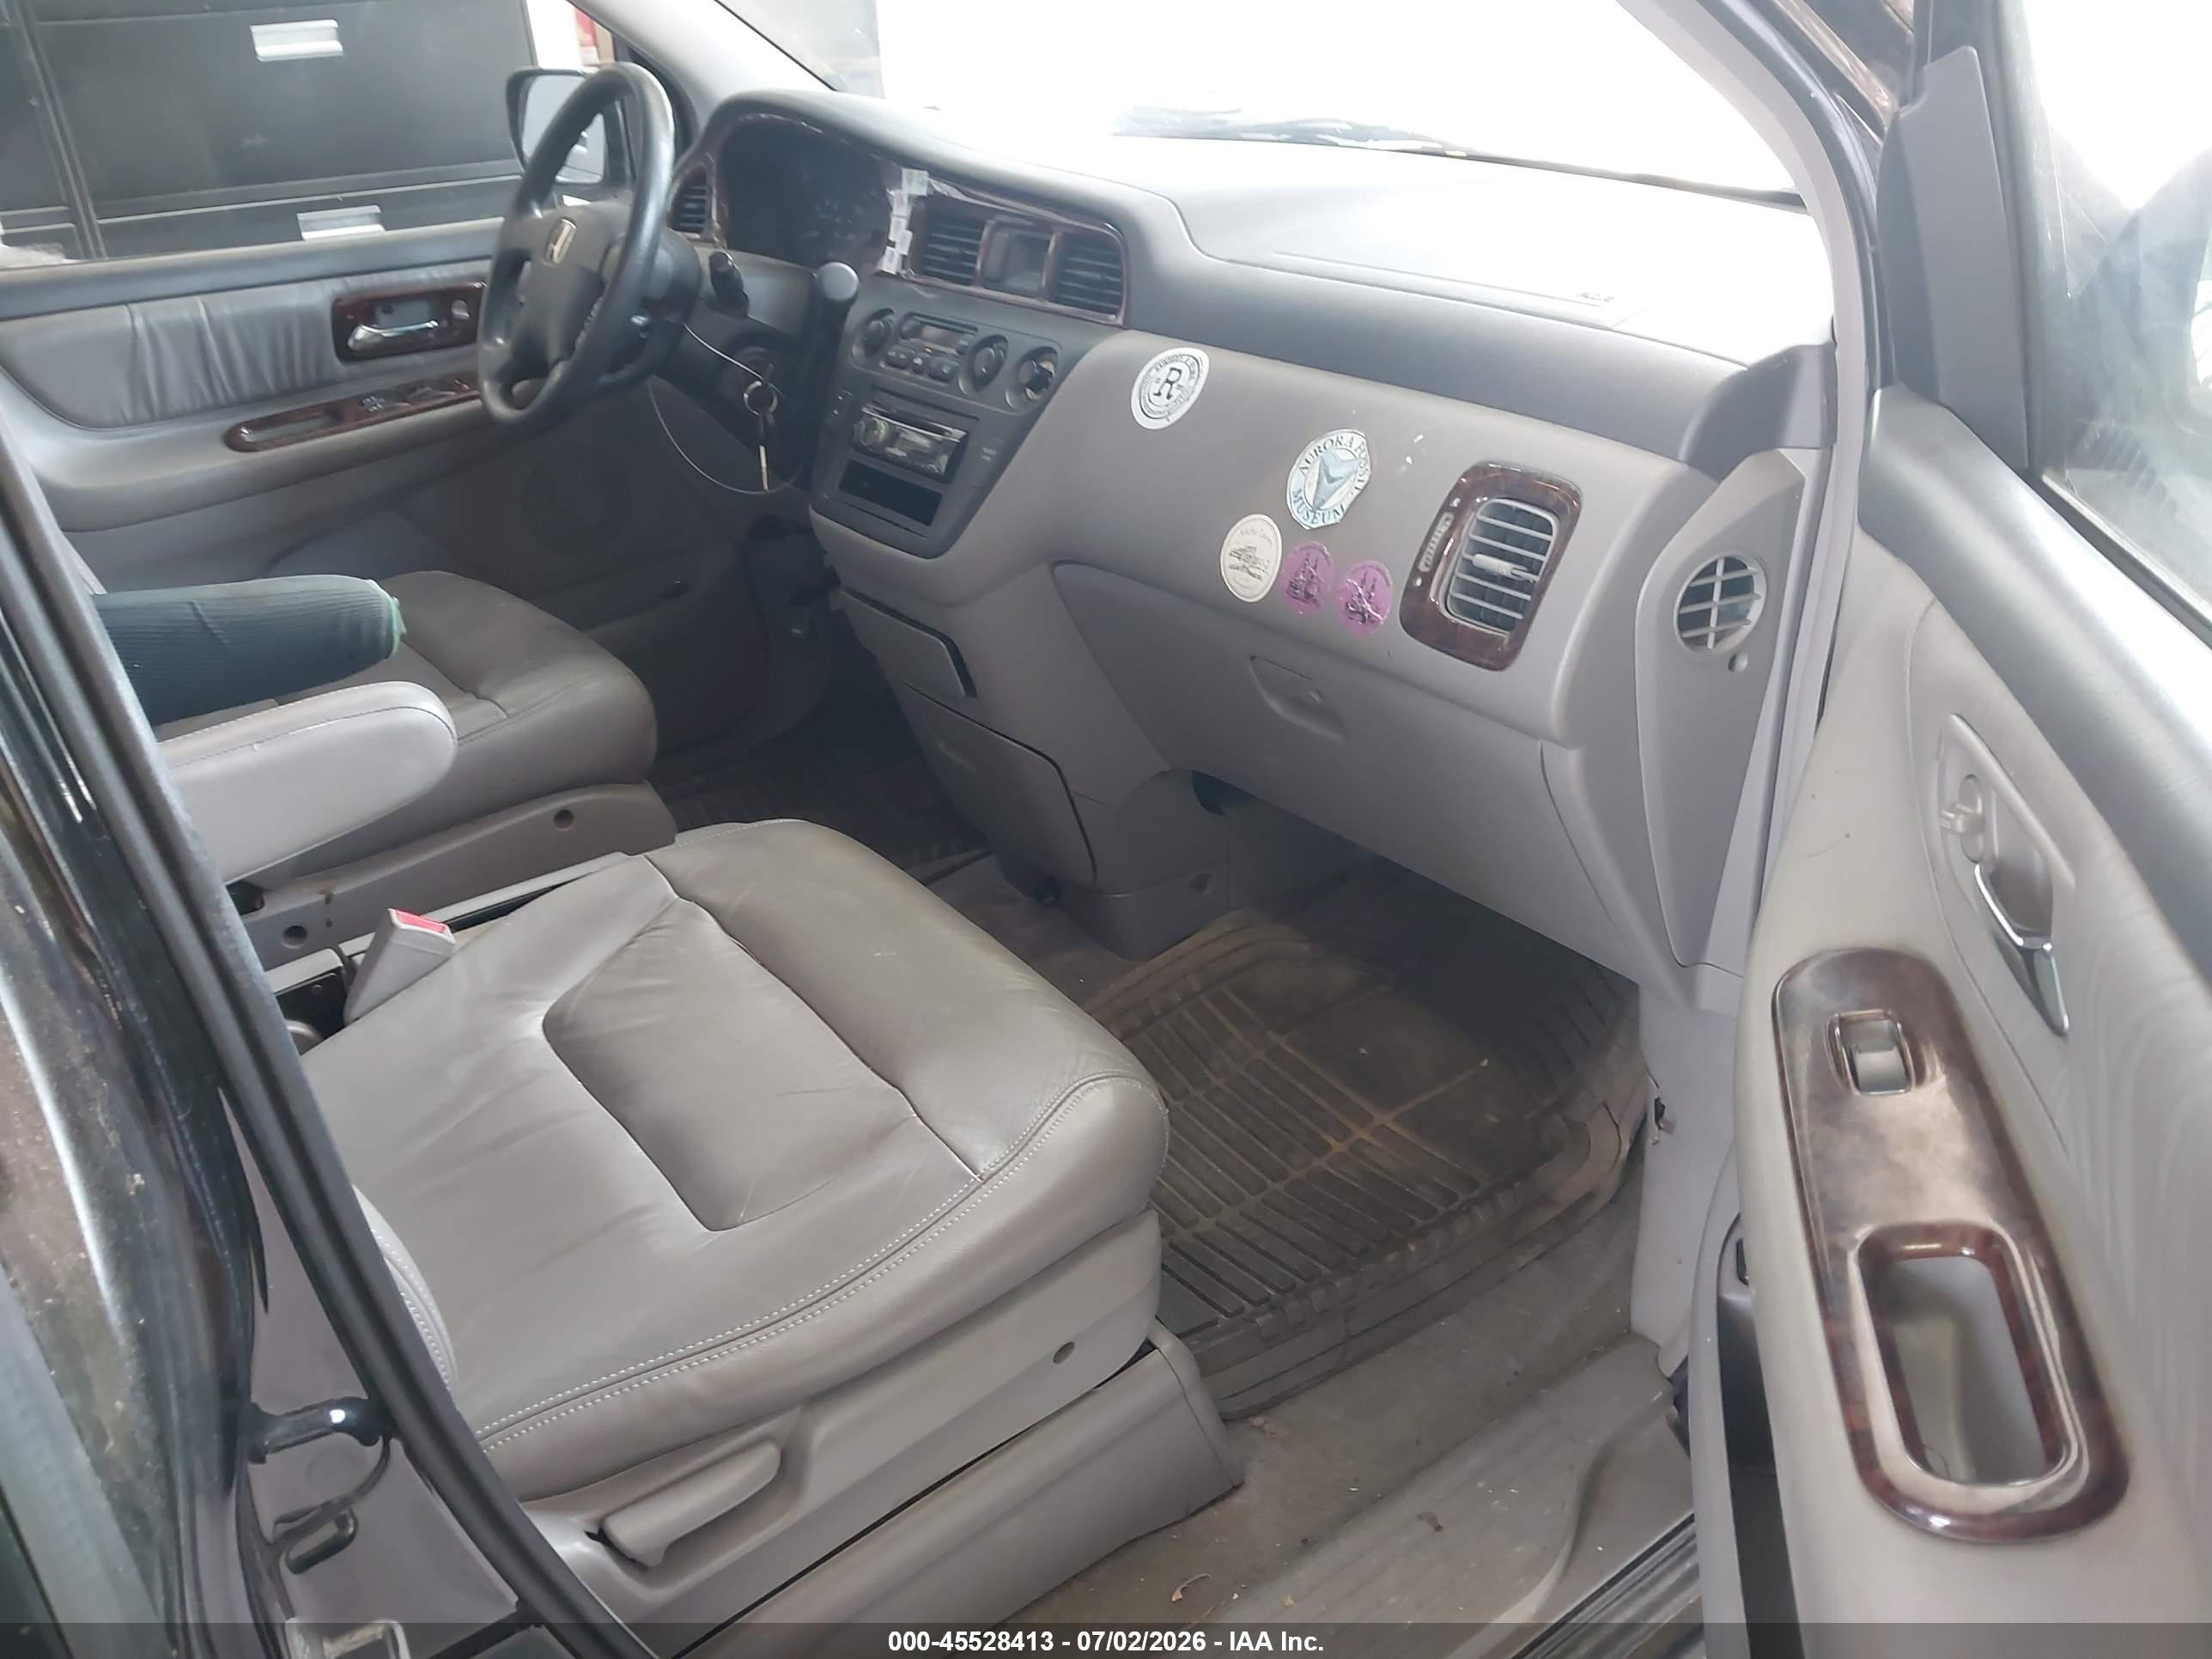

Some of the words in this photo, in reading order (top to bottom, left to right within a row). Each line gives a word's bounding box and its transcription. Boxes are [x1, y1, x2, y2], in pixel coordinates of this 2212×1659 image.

[1153, 368, 1182, 400] R
[1299, 434, 1354, 475] AURORA
[1291, 488, 1346, 525] MUSEUM
